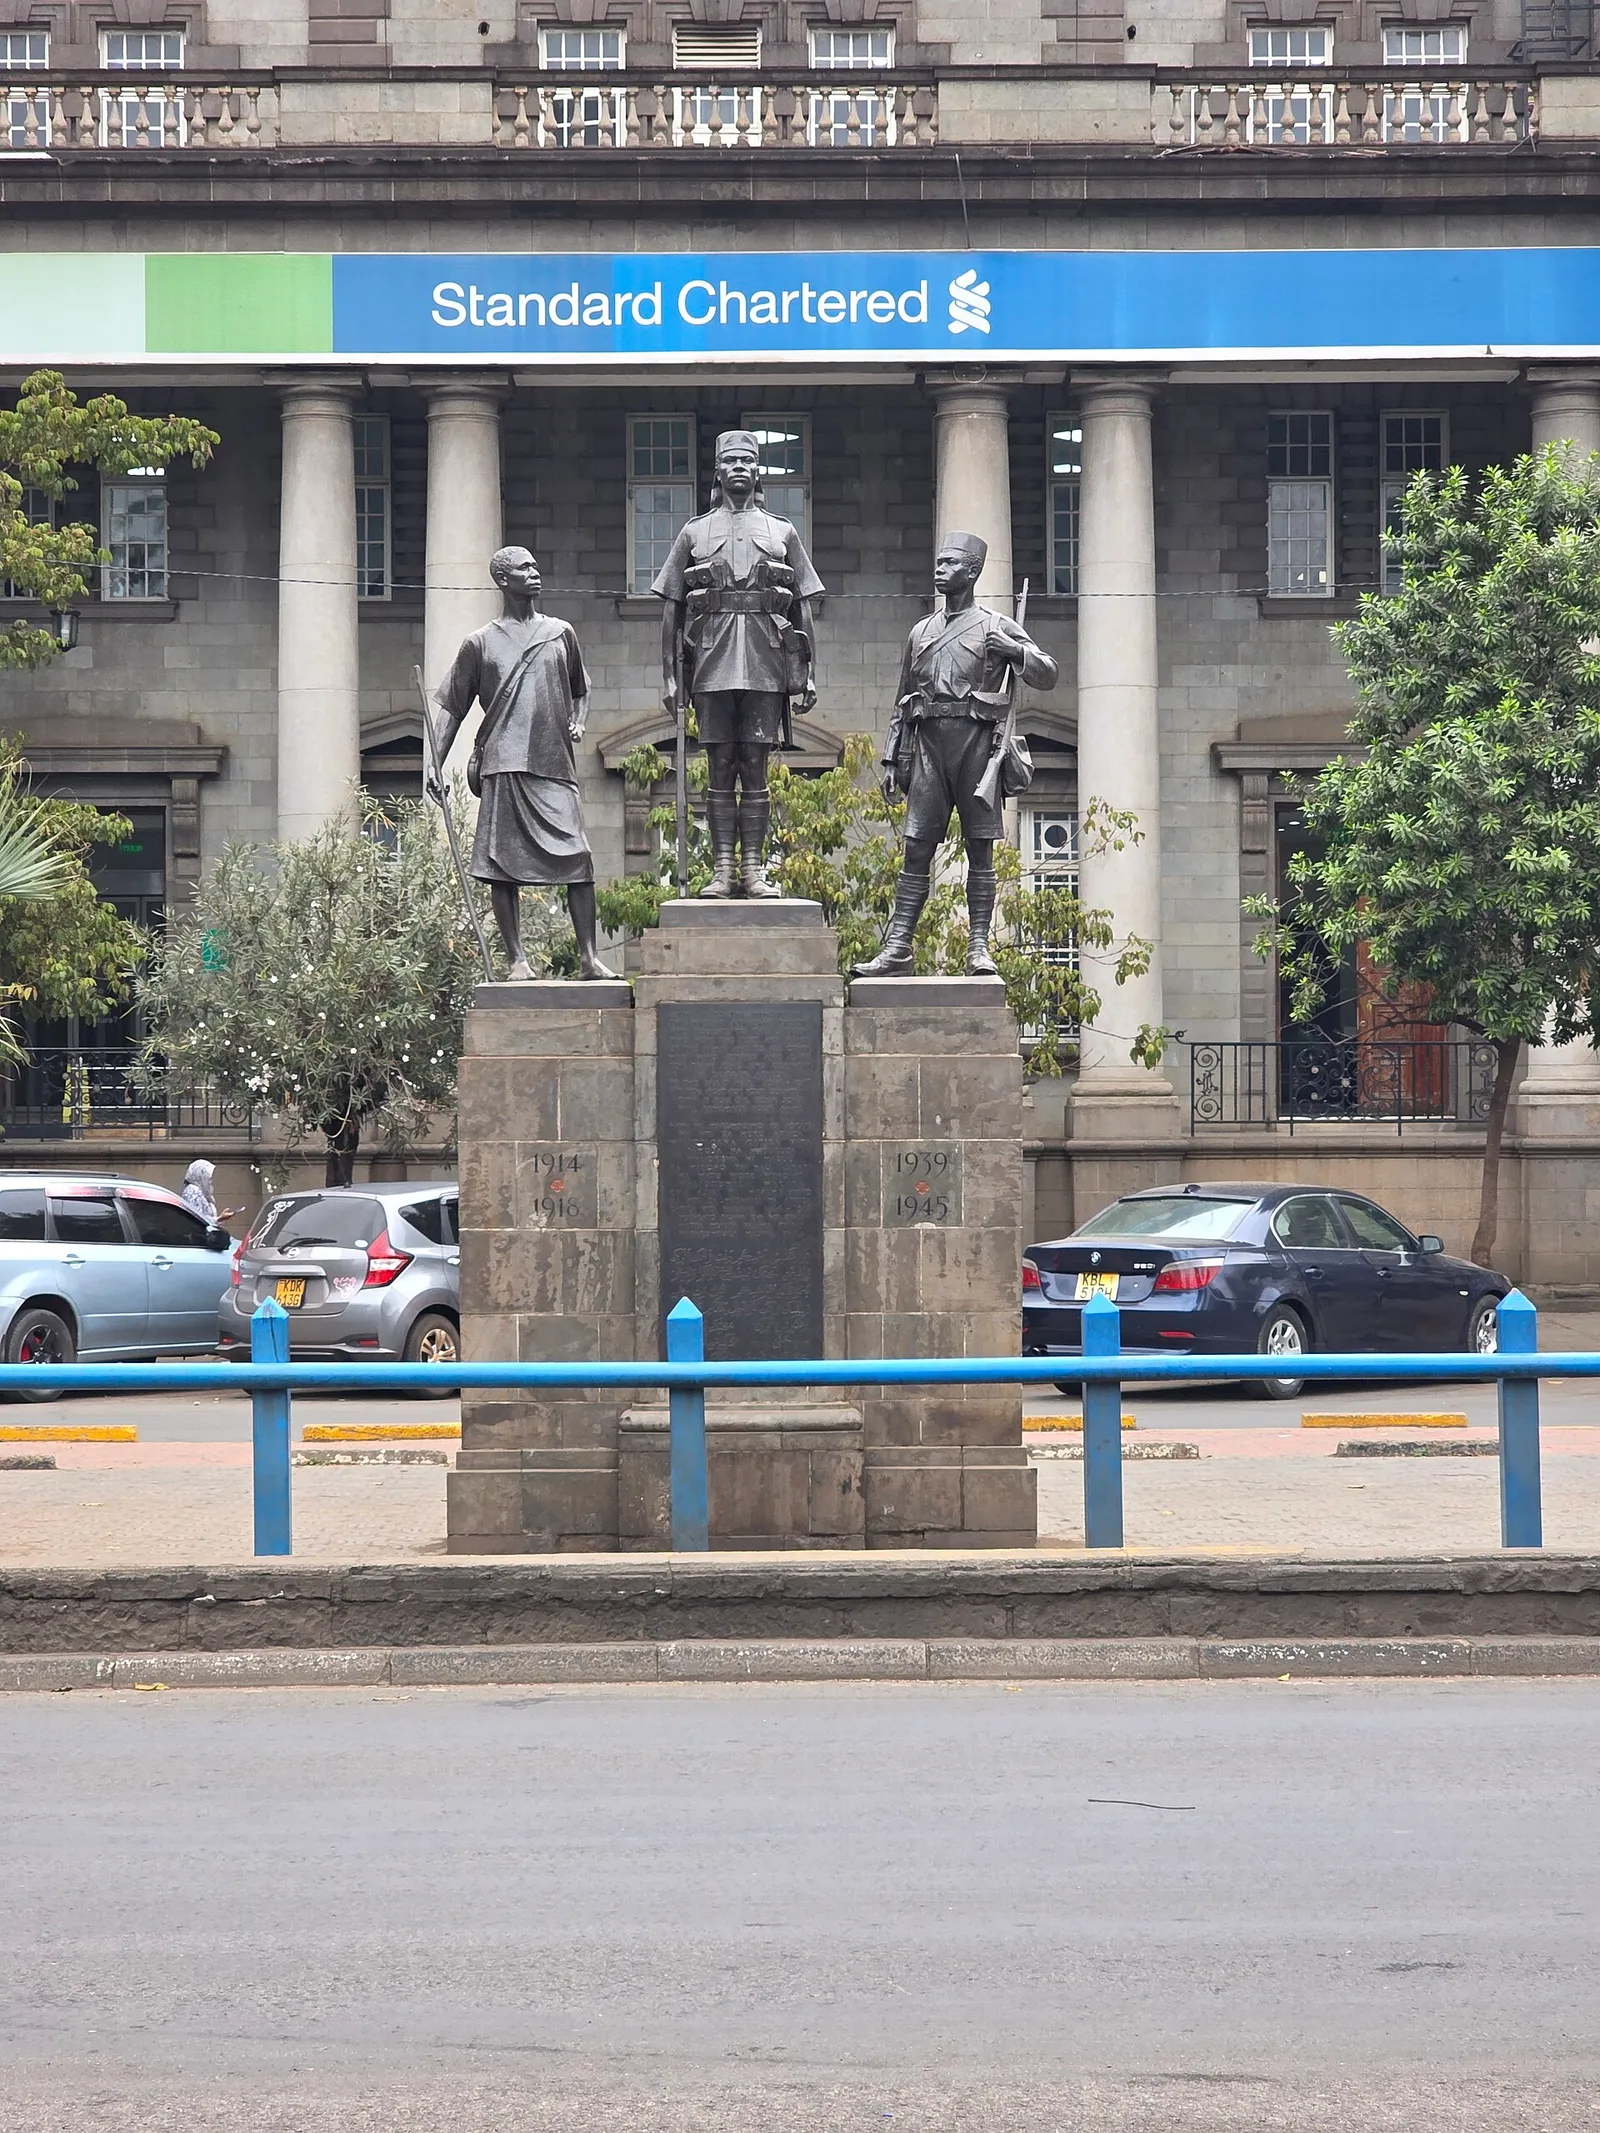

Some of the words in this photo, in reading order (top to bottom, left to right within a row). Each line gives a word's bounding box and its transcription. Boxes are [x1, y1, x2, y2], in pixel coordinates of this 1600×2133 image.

[431, 281, 662, 327] Standard
[678, 279, 929, 325] Chartered
[534, 1152, 581, 1177] 1914
[897, 1152, 948, 1177] 1939
[534, 1197, 579, 1221] 1918
[896, 1196, 948, 1221] 1945
[283, 1279, 303, 1292] KDR
[1082, 1272, 1105, 1286] KBL
